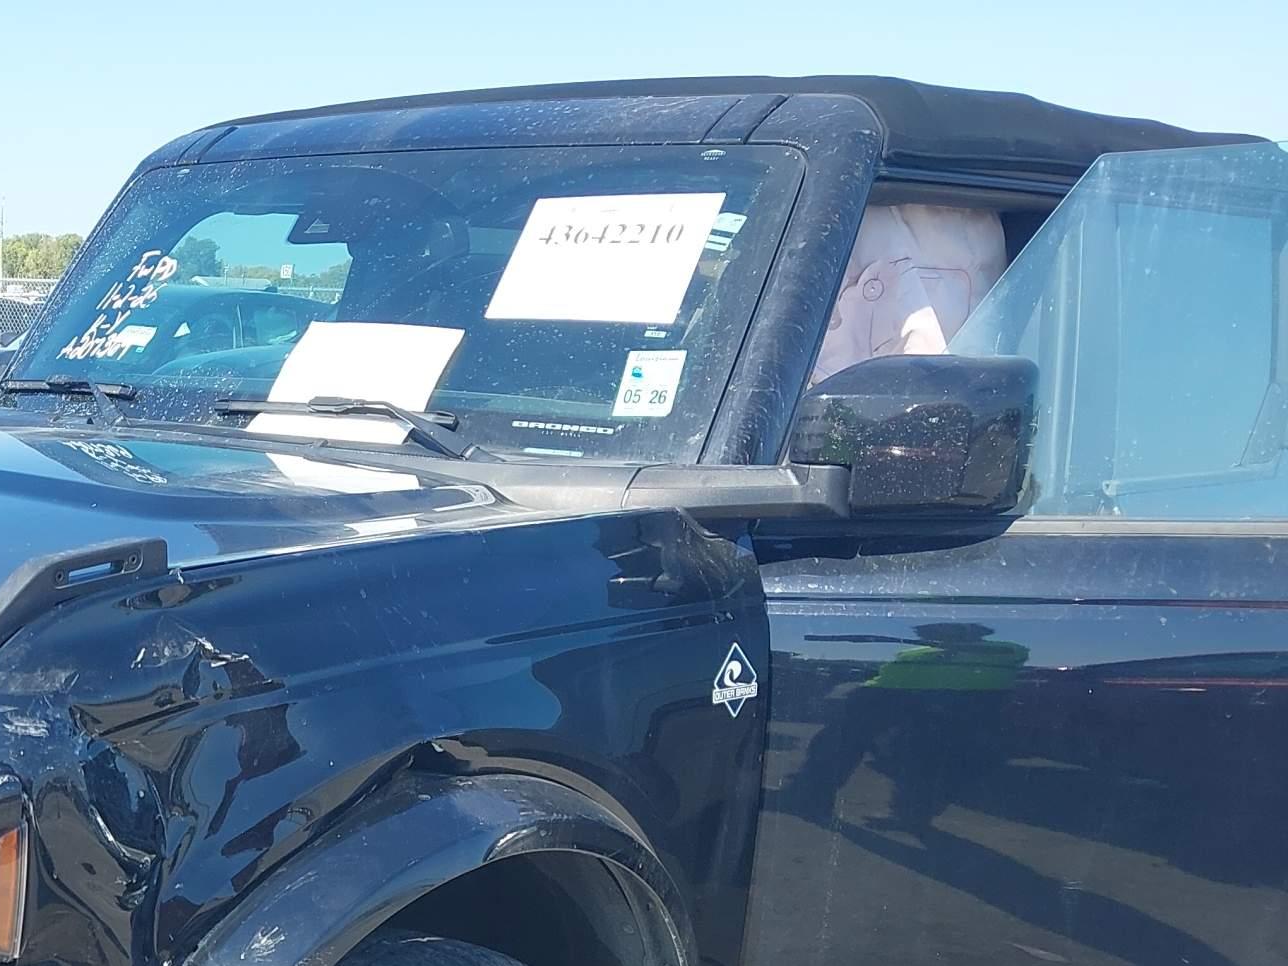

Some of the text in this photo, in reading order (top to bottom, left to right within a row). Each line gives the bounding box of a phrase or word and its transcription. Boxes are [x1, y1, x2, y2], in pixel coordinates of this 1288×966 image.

[538, 223, 685, 245] 43642210
[623, 389, 668, 404] 05 26
[512, 420, 615, 435] BRONCO
[715, 685, 756, 700] OUTER BANKS
